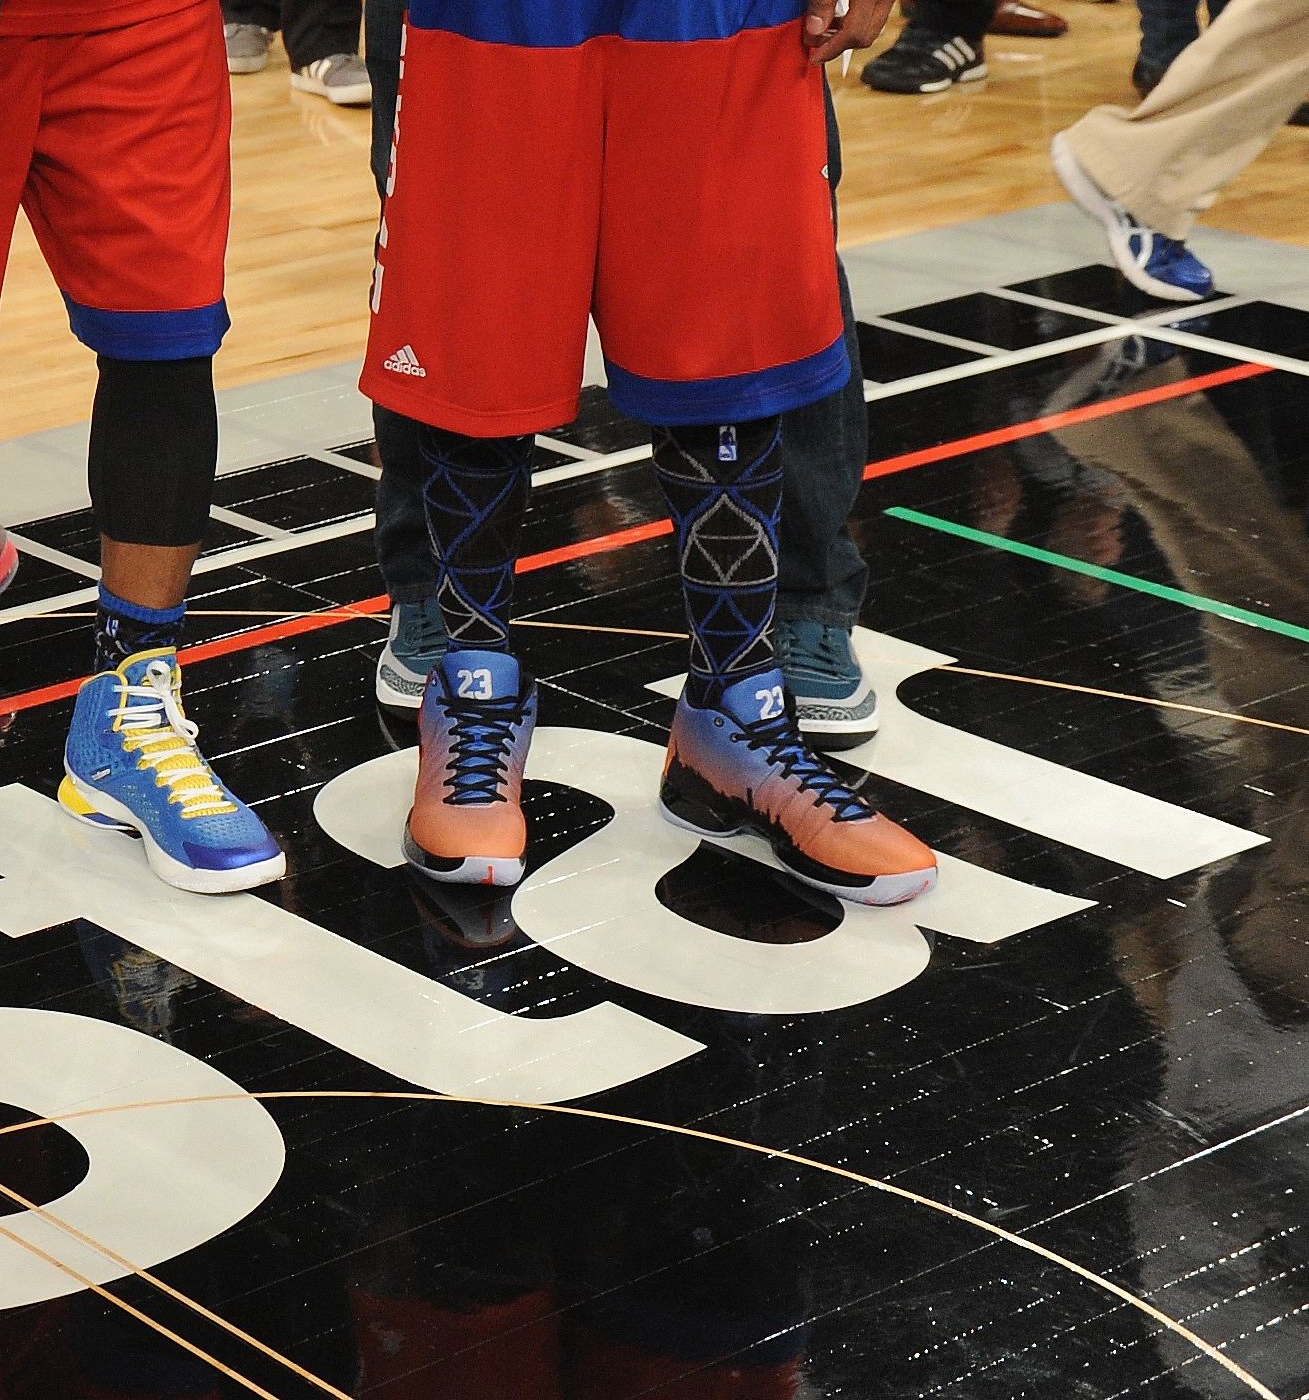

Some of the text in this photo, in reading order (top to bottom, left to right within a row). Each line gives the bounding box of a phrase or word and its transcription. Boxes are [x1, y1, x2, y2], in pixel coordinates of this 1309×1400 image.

[383, 358, 427, 379] adidas
[456, 668, 494, 701] 23
[754, 685, 785, 721] 23
